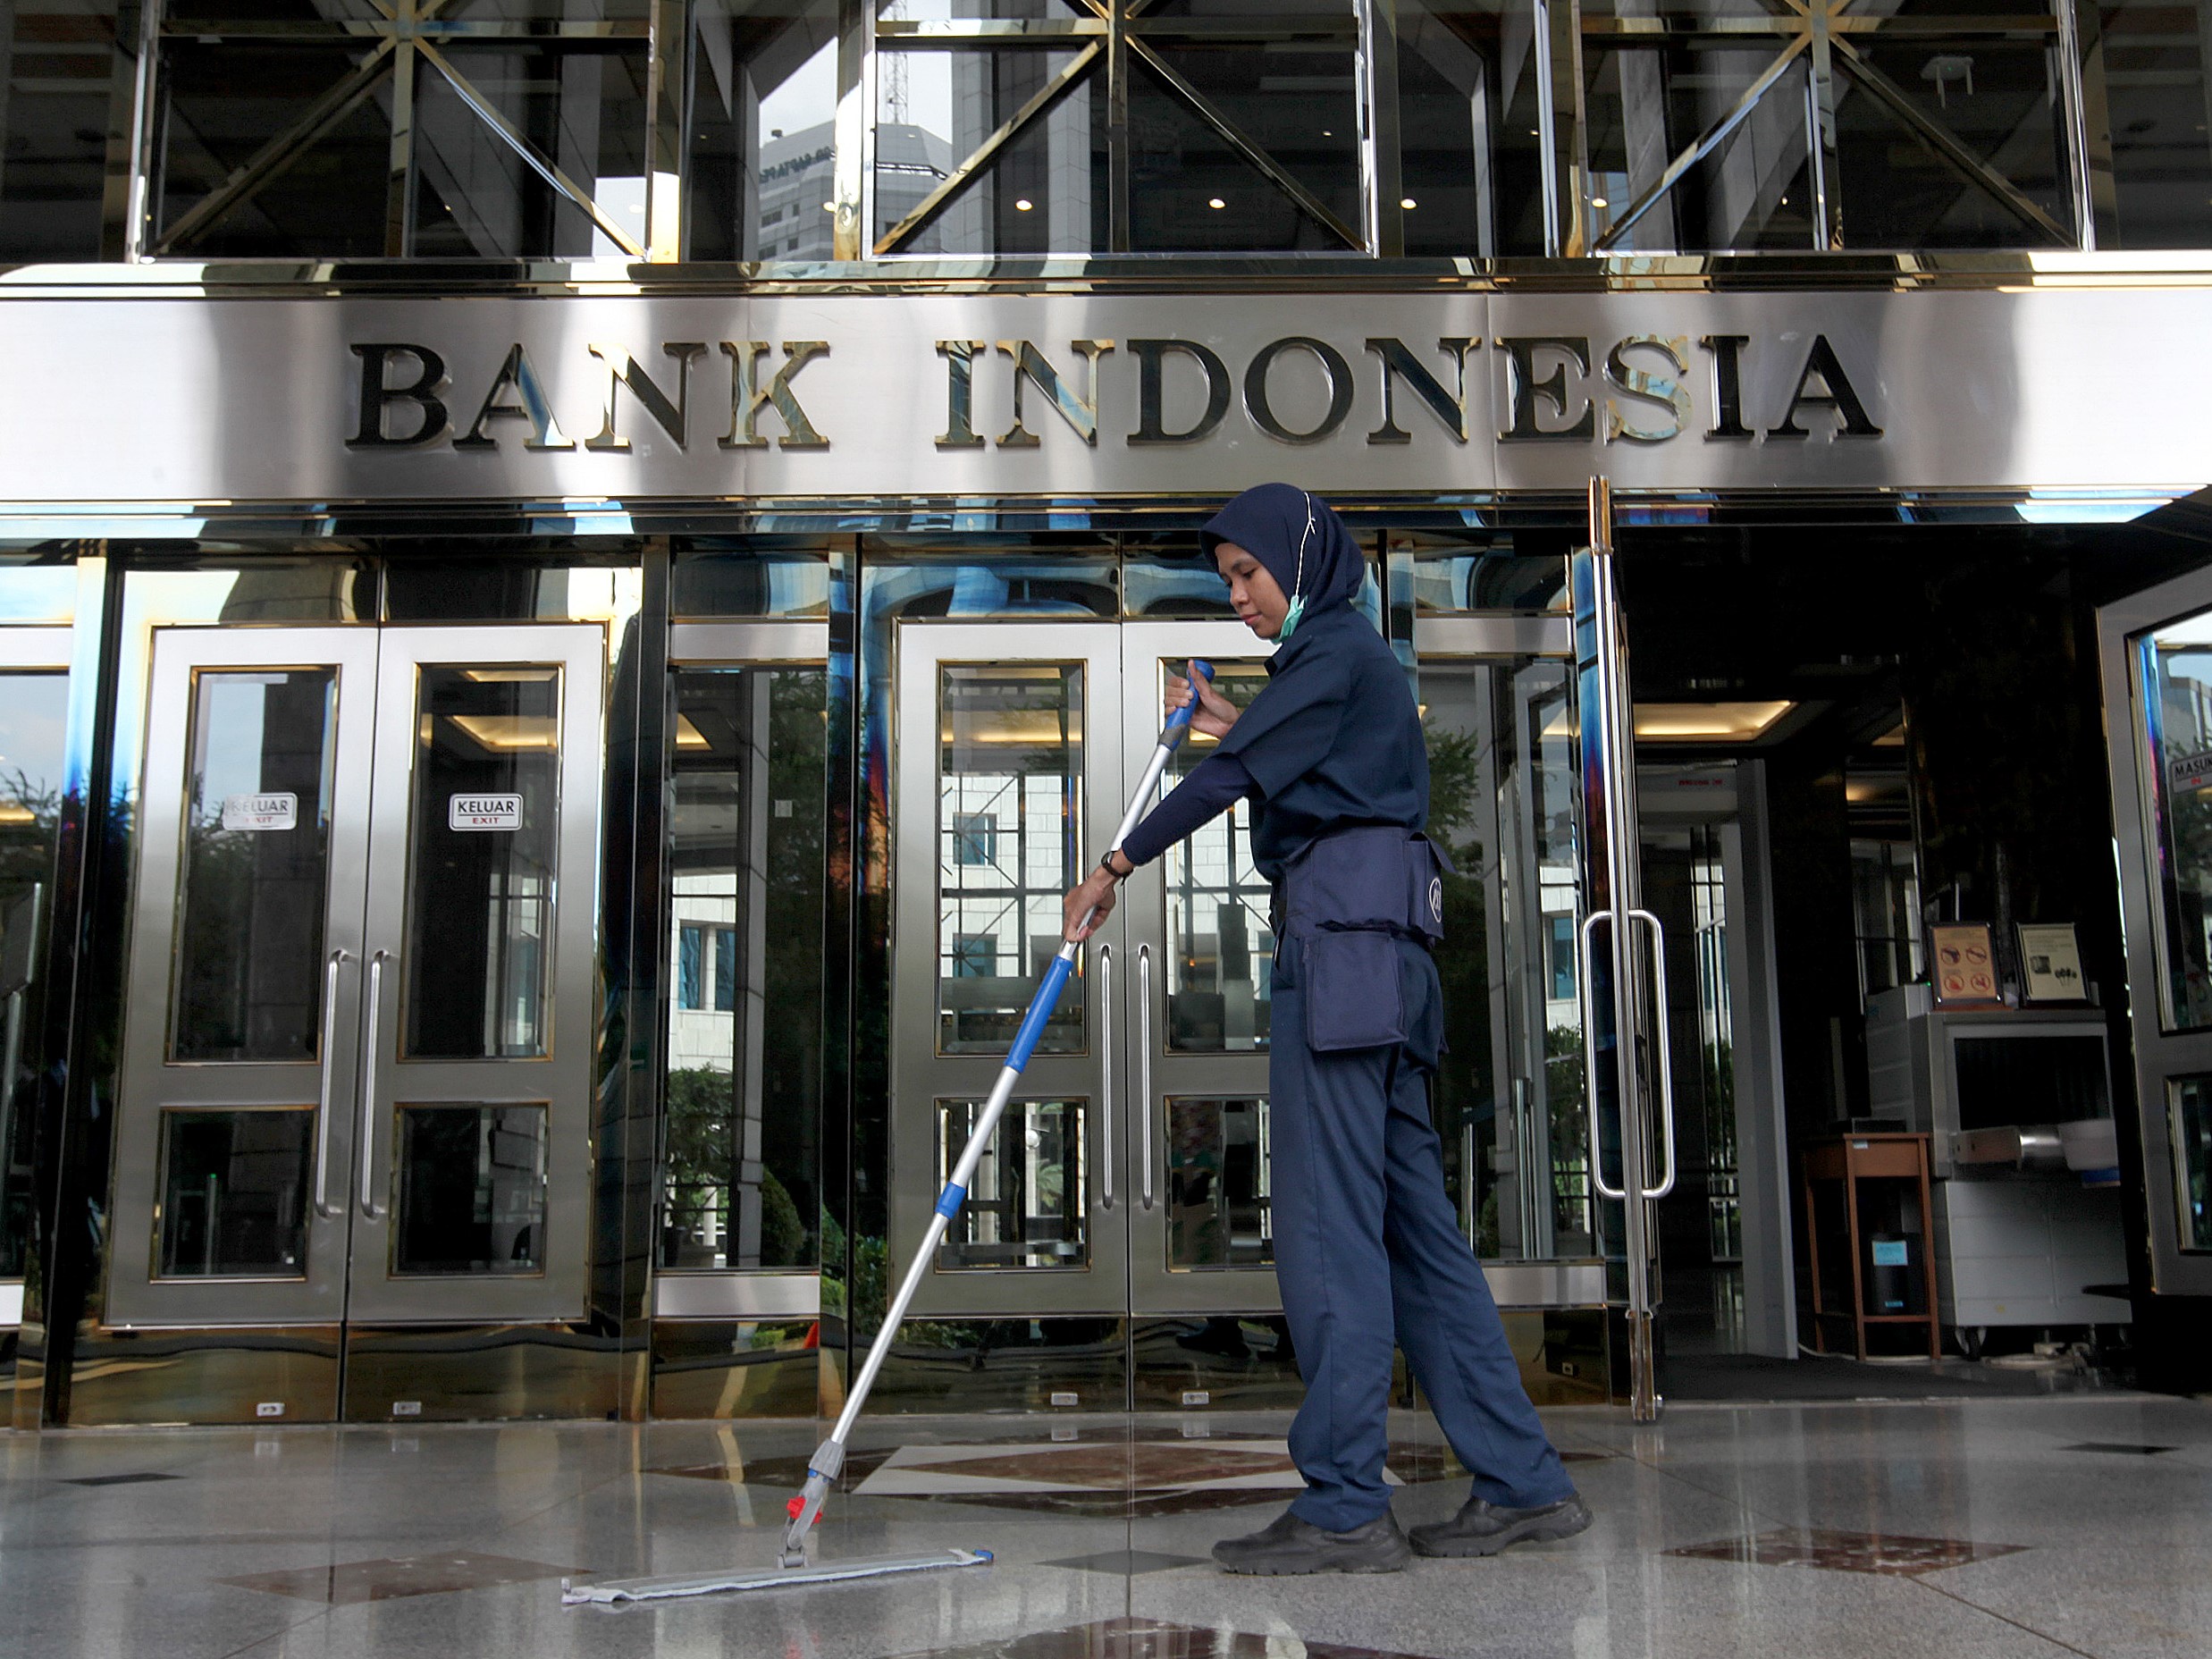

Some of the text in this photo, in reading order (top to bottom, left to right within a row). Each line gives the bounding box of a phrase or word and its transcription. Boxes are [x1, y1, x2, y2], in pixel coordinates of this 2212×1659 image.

[345, 333, 1883, 453] BANK INDONESIA
[231, 800, 289, 813] KELUAR
[458, 801, 515, 813] KELUAR
